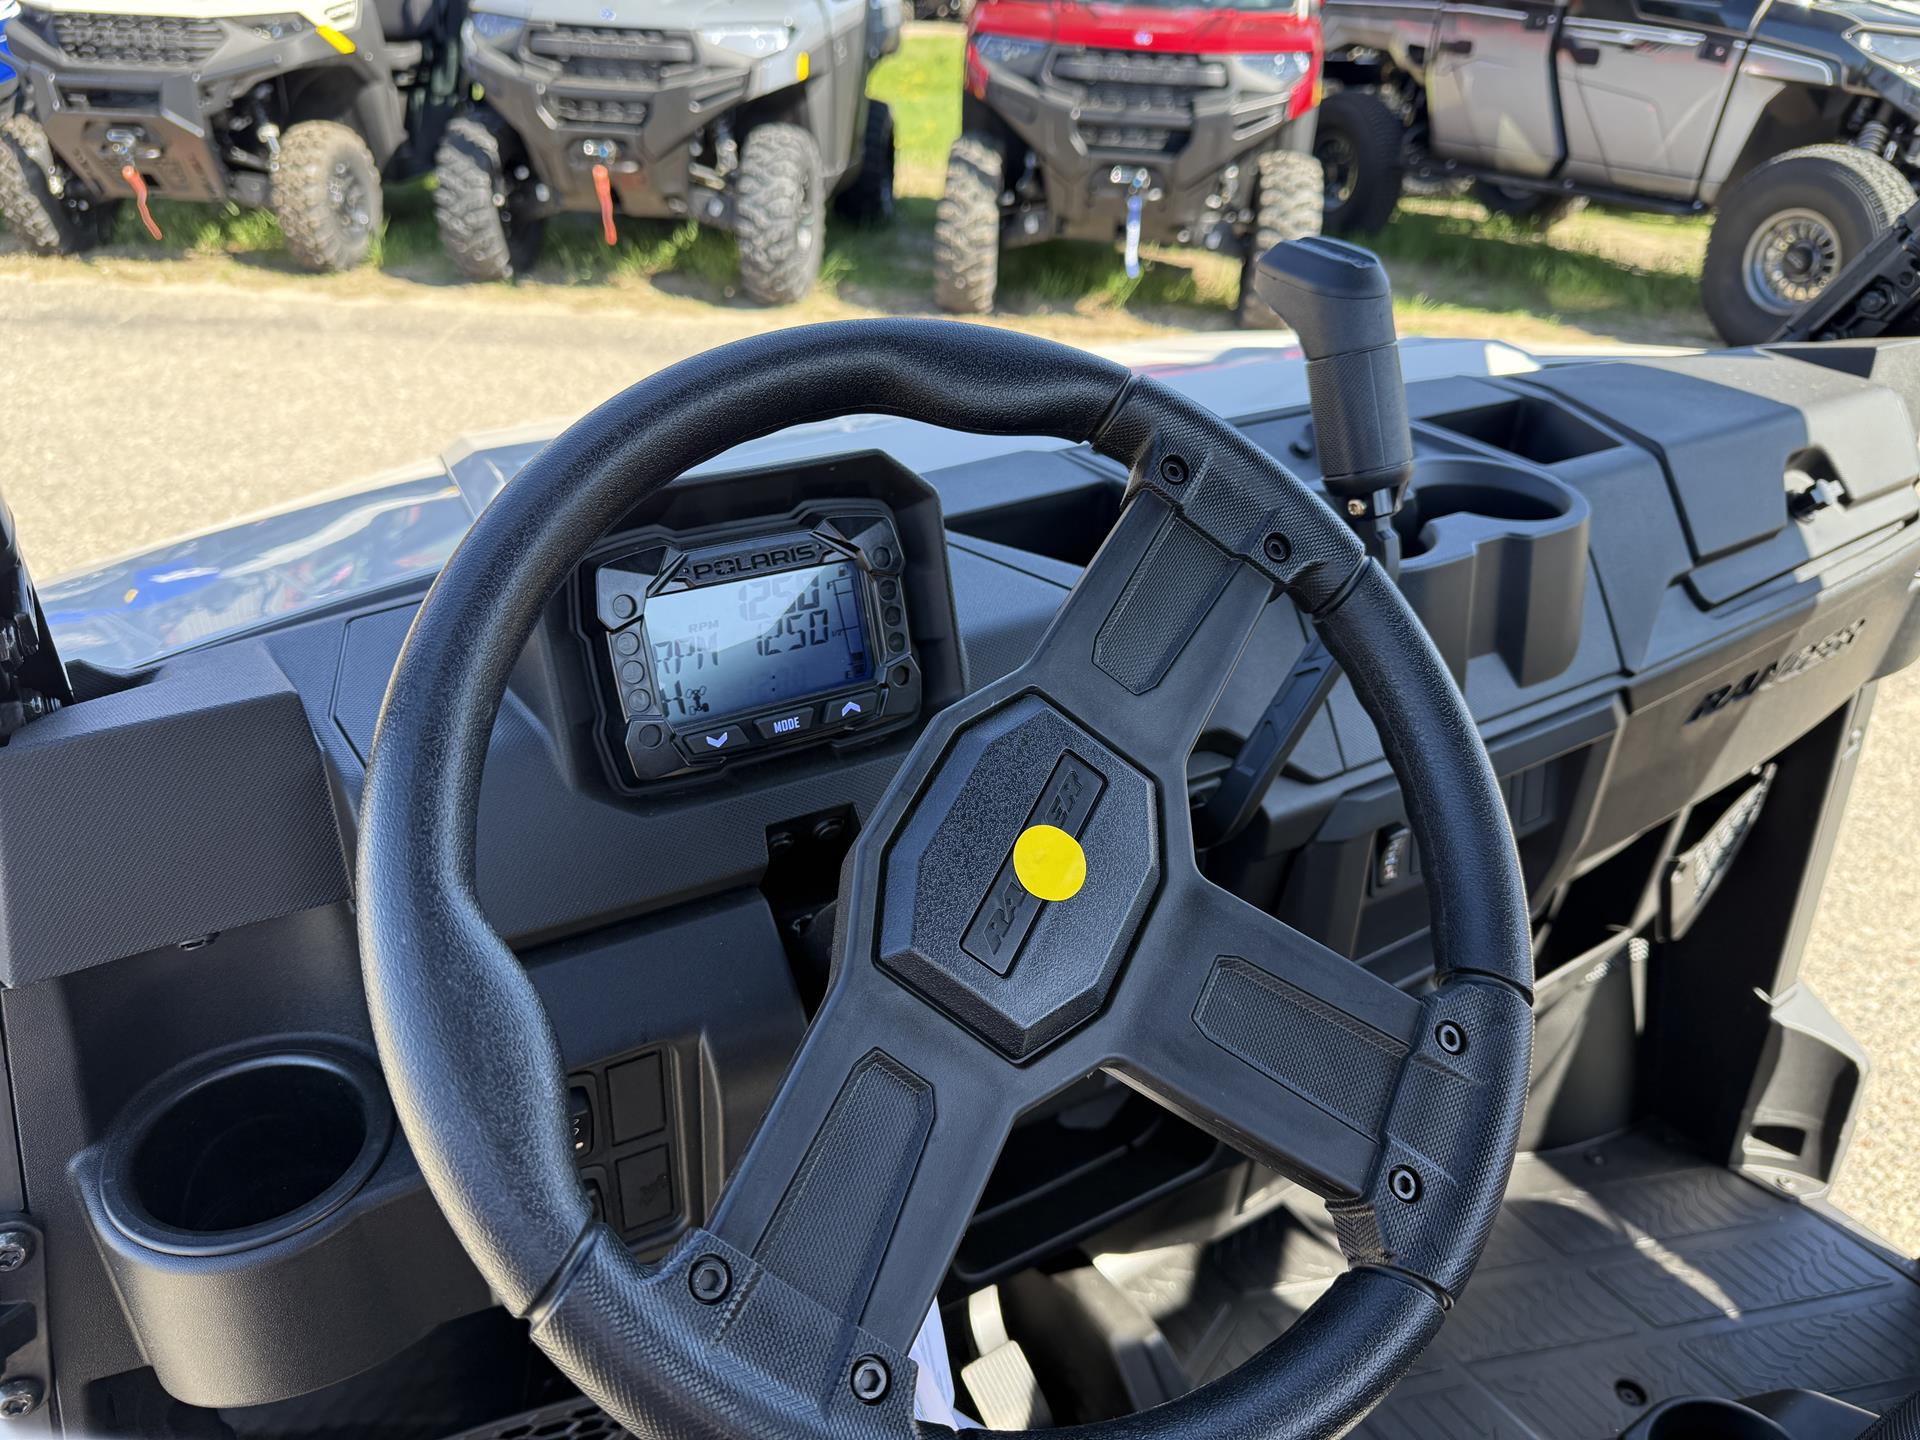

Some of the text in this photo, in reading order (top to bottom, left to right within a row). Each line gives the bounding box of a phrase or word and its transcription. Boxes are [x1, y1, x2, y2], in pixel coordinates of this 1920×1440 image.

[693, 544, 817, 579] POLARIS
[688, 619, 719, 633] RPM
[773, 716, 800, 734] MODE
[983, 769, 1085, 957] RAER
